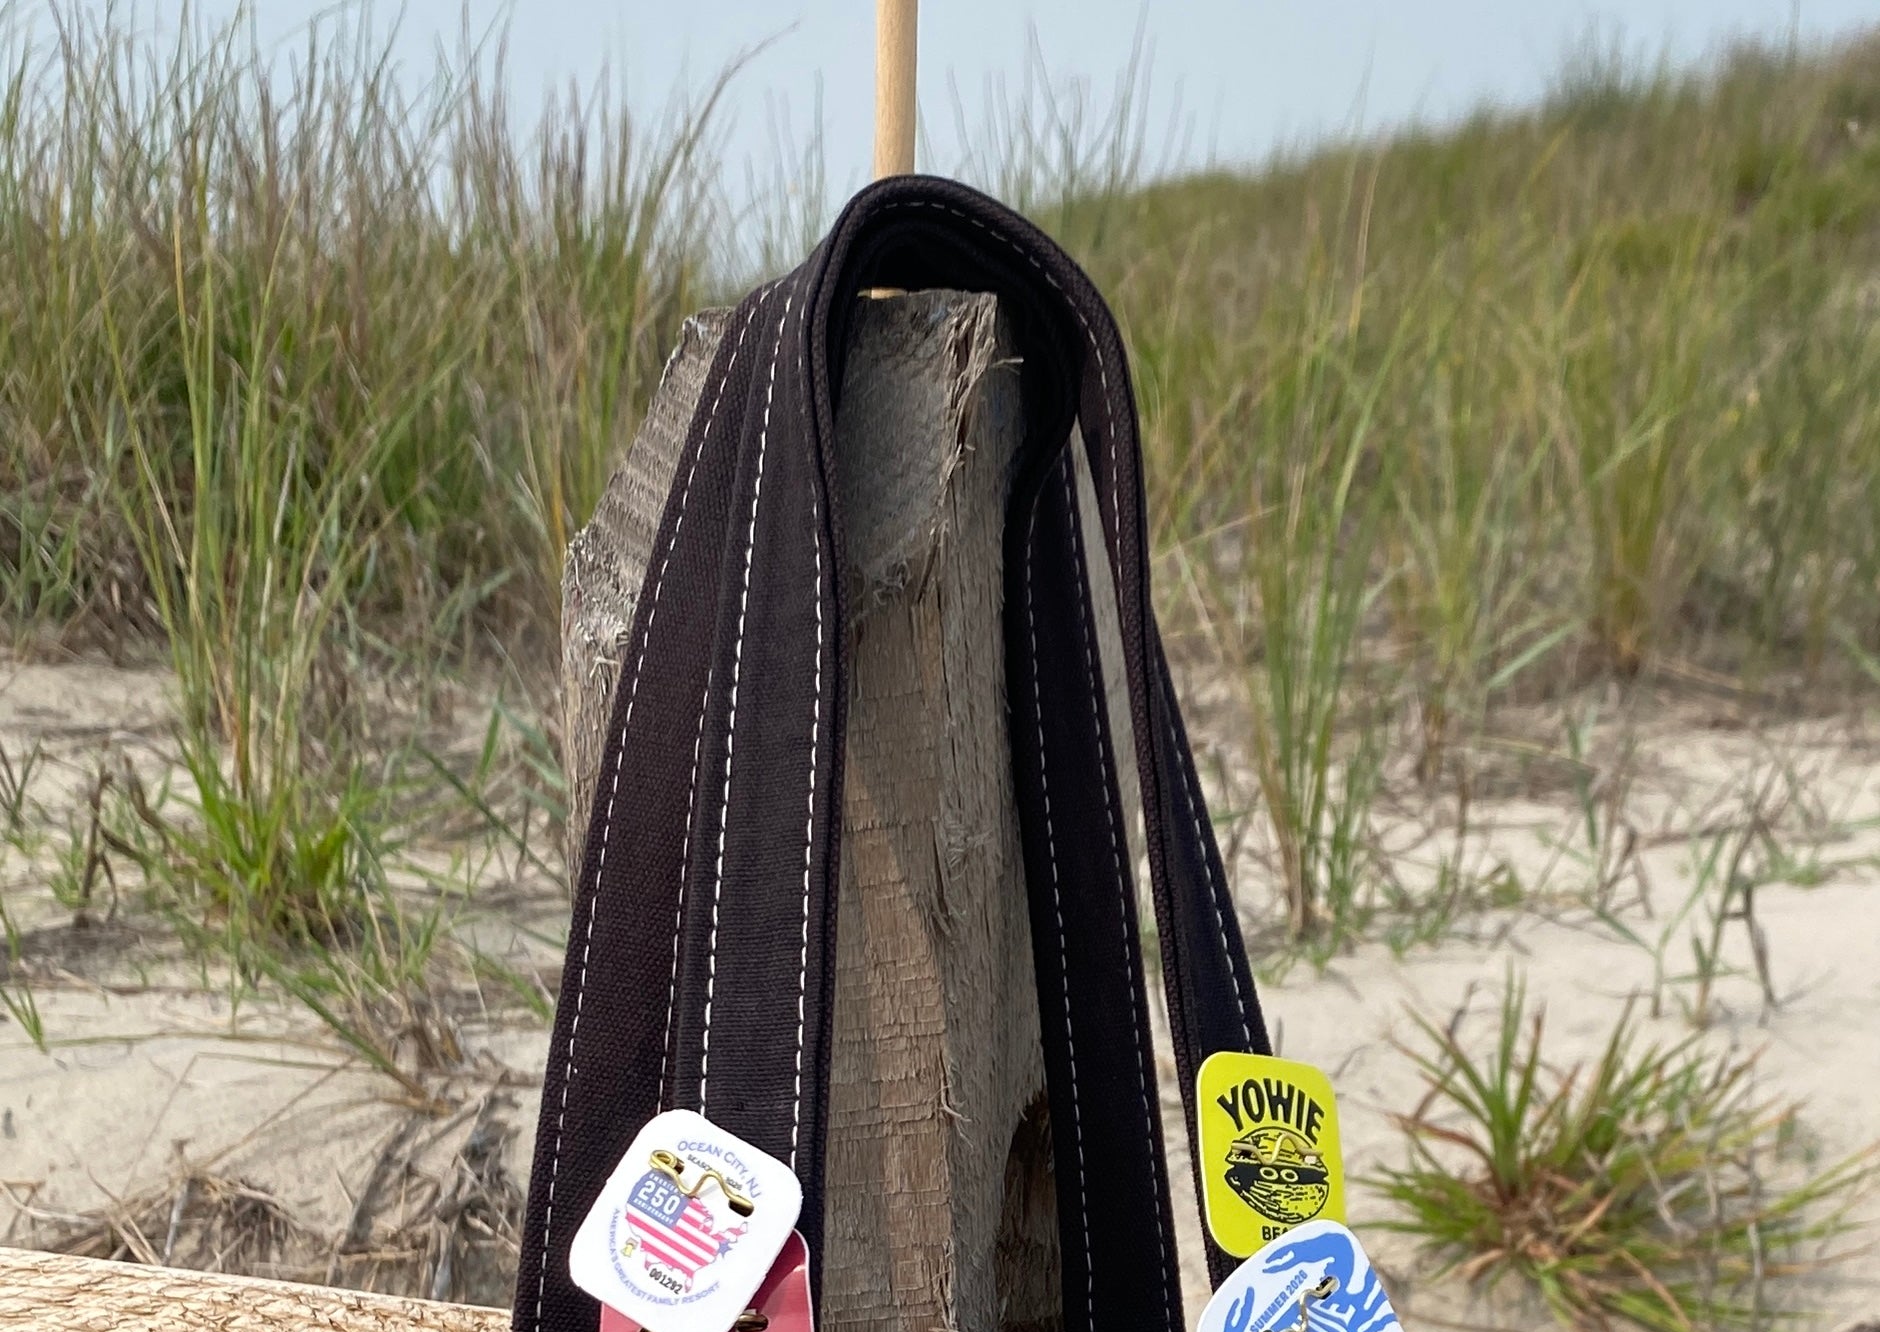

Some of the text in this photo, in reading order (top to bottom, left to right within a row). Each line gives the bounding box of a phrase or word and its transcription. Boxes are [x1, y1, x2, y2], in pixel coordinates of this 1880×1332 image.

[1216, 1077, 1325, 1146] YOWIE
[677, 1140, 723, 1158] OCEAN
[746, 1177, 763, 1199] NJ
[637, 1180, 681, 1216] 250
[613, 1262, 647, 1299] GREATEST
[646, 1293, 680, 1306] FAMILY
[681, 1281, 720, 1304] RESORT
